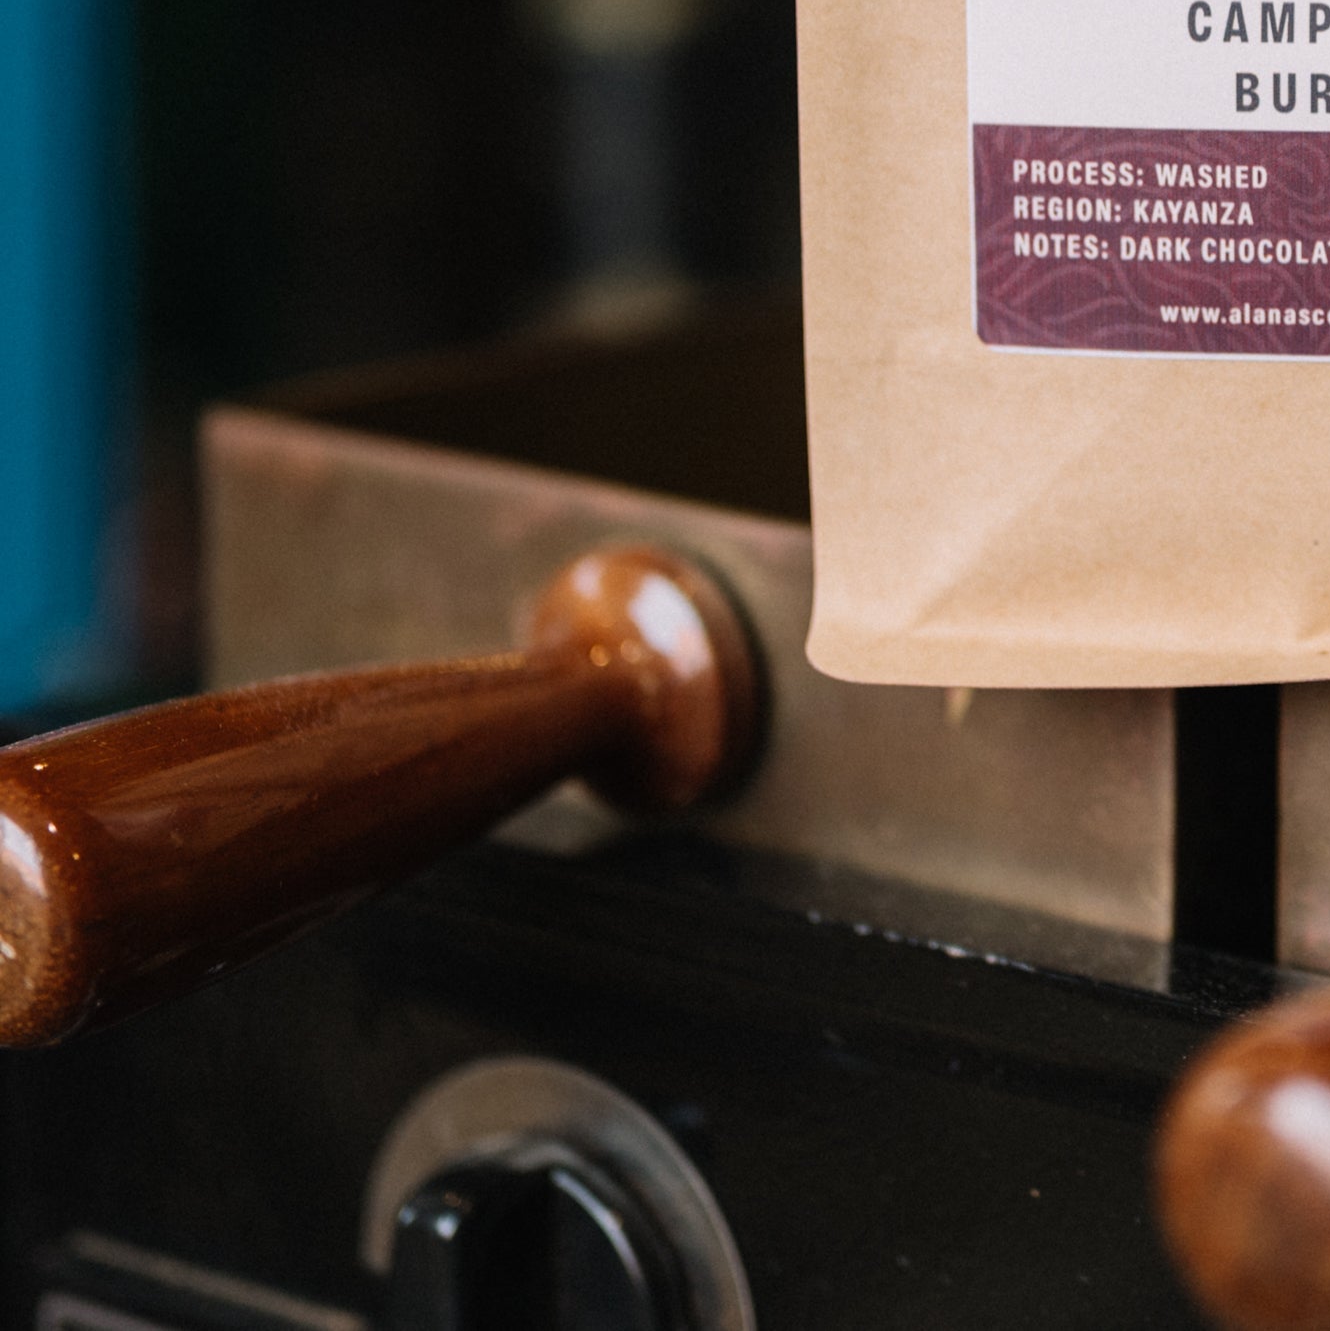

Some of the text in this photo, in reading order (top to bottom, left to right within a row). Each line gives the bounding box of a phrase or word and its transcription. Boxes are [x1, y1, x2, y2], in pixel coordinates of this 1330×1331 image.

[1012, 158, 1268, 190] PROCESS: WASHED
[1013, 196, 1254, 227] REGION: KAYANZA
[1013, 233, 1110, 261] NOTES:
[1119, 237, 1192, 263] DARK
